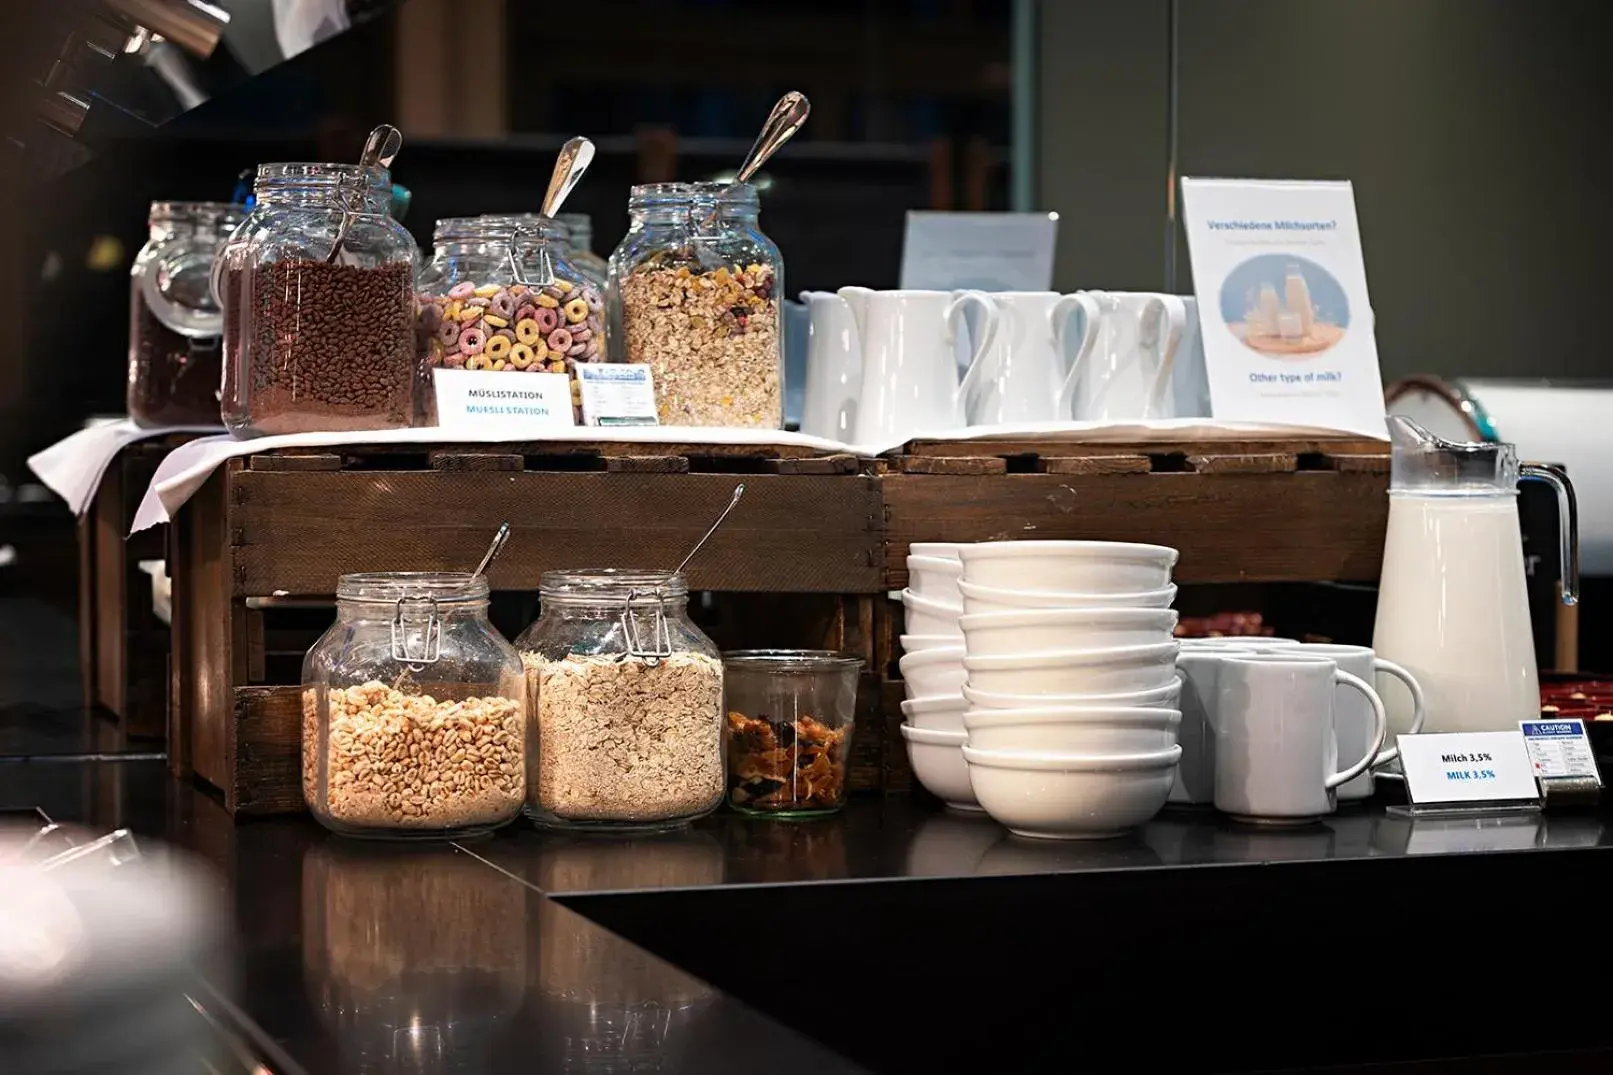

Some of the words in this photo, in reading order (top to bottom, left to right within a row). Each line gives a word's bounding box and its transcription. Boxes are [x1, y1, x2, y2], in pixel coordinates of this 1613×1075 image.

[1249, 373, 1278, 383] Other
[1280, 374, 1302, 383] type
[1304, 373, 1315, 383] of
[1316, 373, 1342, 382] milk?
[468, 389, 543, 399] MÜSLISTATION
[505, 406, 549, 416] STATION
[1441, 753, 1468, 763] Milch
[1469, 753, 1493, 762] 3,5%
[1447, 771, 1471, 780] MILK
[1473, 770, 1496, 779] 3,5%
